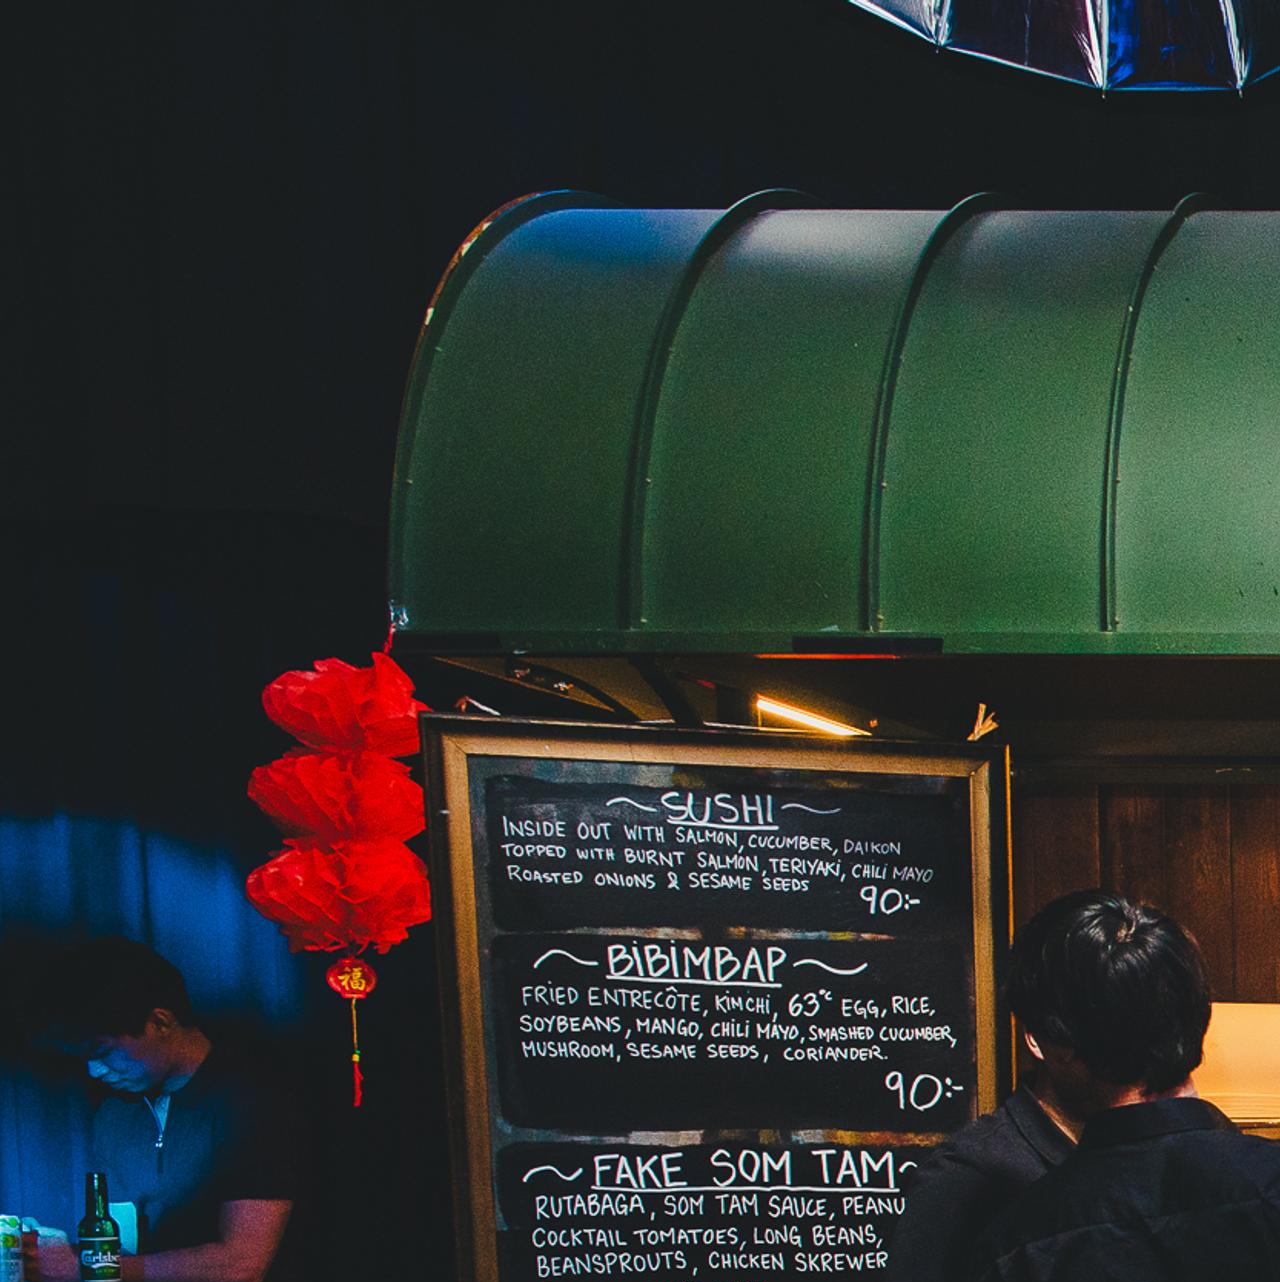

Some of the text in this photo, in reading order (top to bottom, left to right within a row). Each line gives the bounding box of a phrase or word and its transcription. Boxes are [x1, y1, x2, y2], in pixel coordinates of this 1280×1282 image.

[659, 791, 776, 824] SUSHI
[502, 815, 566, 838] INSIDE
[576, 821, 612, 841] OUT
[623, 824, 665, 843] WITH
[675, 827, 744, 853] SALMON,
[843, 838, 901, 855] DAIKON
[500, 843, 567, 859] TOPPED
[575, 847, 615, 861] WITH
[623, 847, 686, 868] BURNT
[697, 851, 764, 876] SALMON,
[892, 866, 933, 883] MAYO
[506, 864, 810, 892] ROASTED ONIONS & SESAME SEEDS
[337, 966, 366, 991] 福
[588, 986, 708, 1017] ENTRECÔTE,
[841, 998, 887, 1020] EGG,
[891, 995, 936, 1017] RICE,
[519, 1014, 632, 1040] SOYBEANS,
[635, 1017, 704, 1041] MANGO,
[756, 1023, 805, 1045] MAYO,
[808, 1024, 875, 1043] SMASHED
[521, 1040, 621, 1063] MUSHROOM,
[626, 1041, 696, 1059] SESAME
[706, 1043, 769, 1064] SEEDS,
[593, 1148, 896, 1190] FAKE SOM TAM
[535, 1193, 655, 1221] RUTABAGA,
[663, 1194, 704, 1216] SOM
[714, 1193, 759, 1217] TAM
[767, 1194, 835, 1221] SAUCE,
[531, 1223, 883, 1252] COCKTAIL TOMATOES, LONG BEANS,
[536, 1250, 888, 1278] BEANSPROUTS, CHICKEN SKREWER
